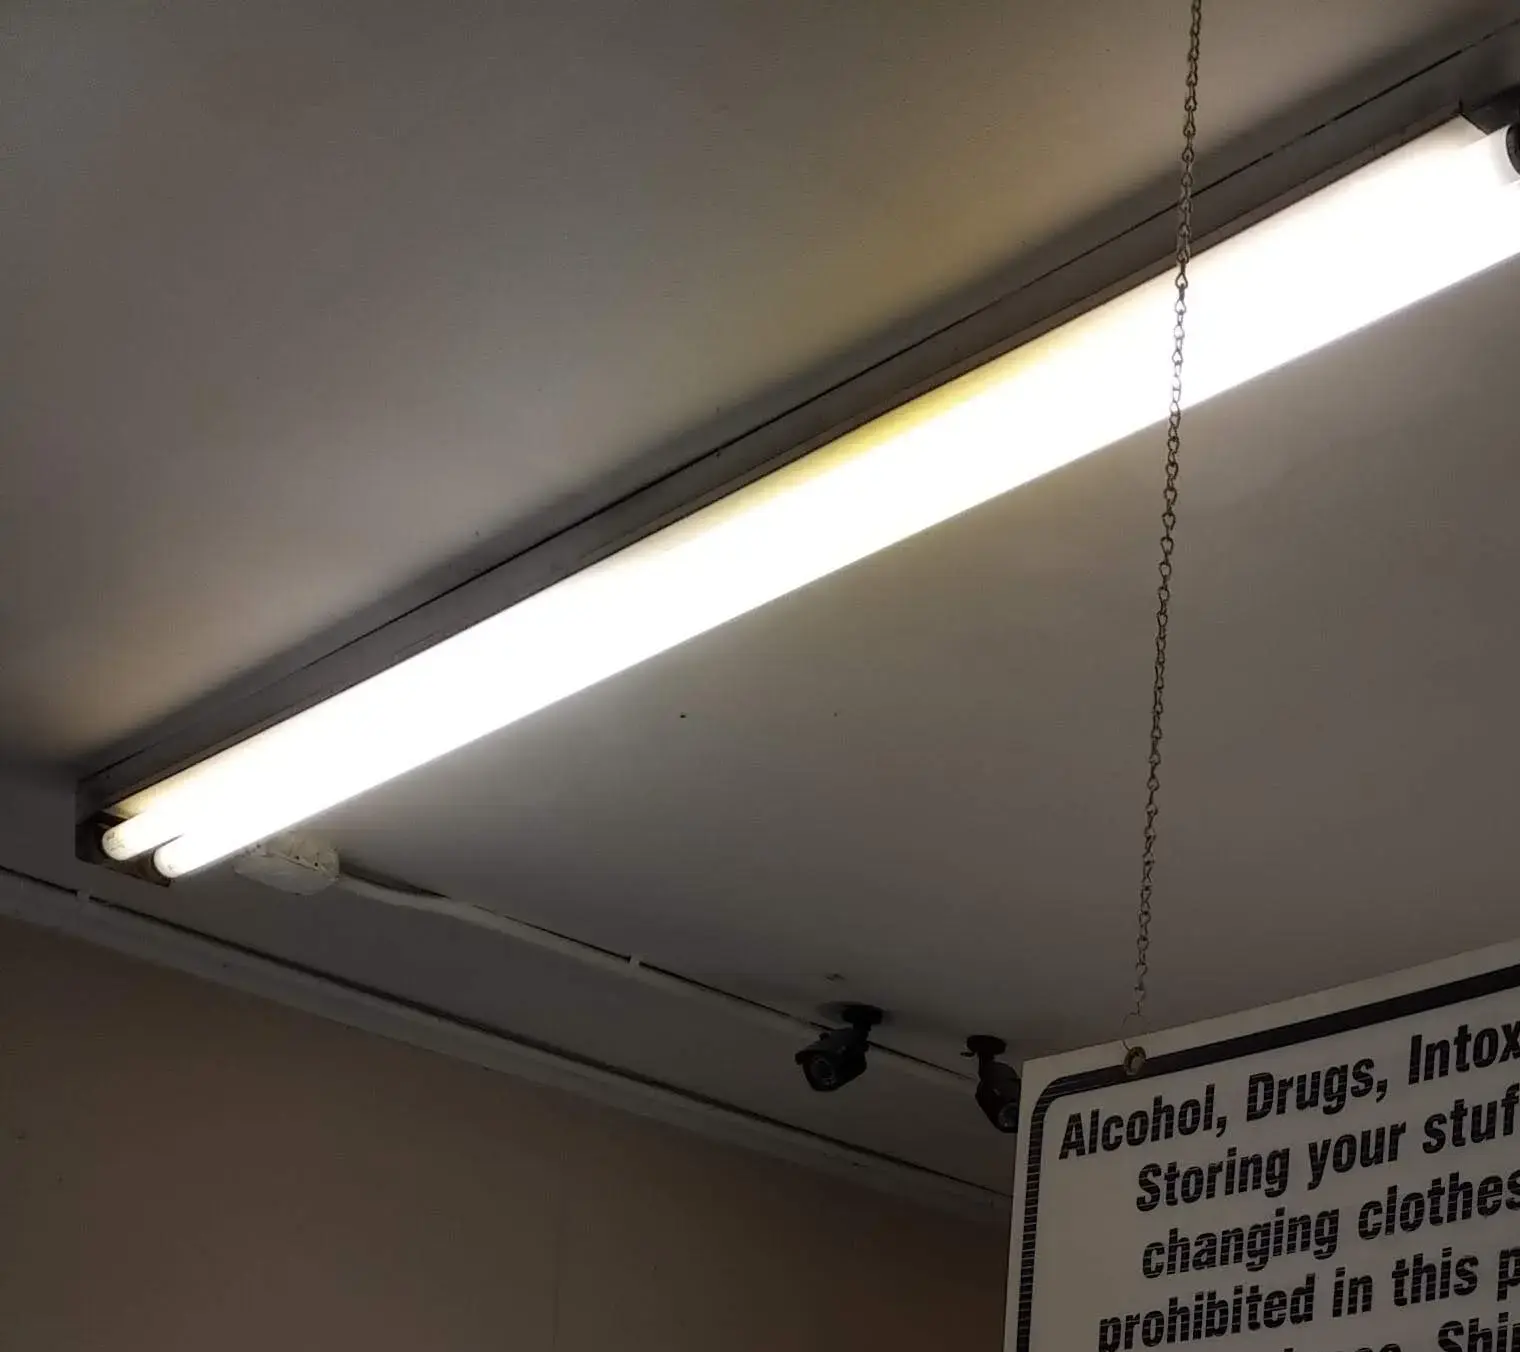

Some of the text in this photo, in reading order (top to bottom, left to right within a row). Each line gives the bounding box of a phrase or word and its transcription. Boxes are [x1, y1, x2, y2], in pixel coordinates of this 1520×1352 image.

[1059, 1084, 1228, 1160] Alcohol,
[1246, 1055, 1388, 1122] Drugs,
[1136, 1145, 1291, 1212] Storing
[1308, 1118, 1407, 1190] your
[1142, 1208, 1340, 1279] changing
[1331, 1267, 1373, 1318] in
[1392, 1248, 1479, 1306] this
